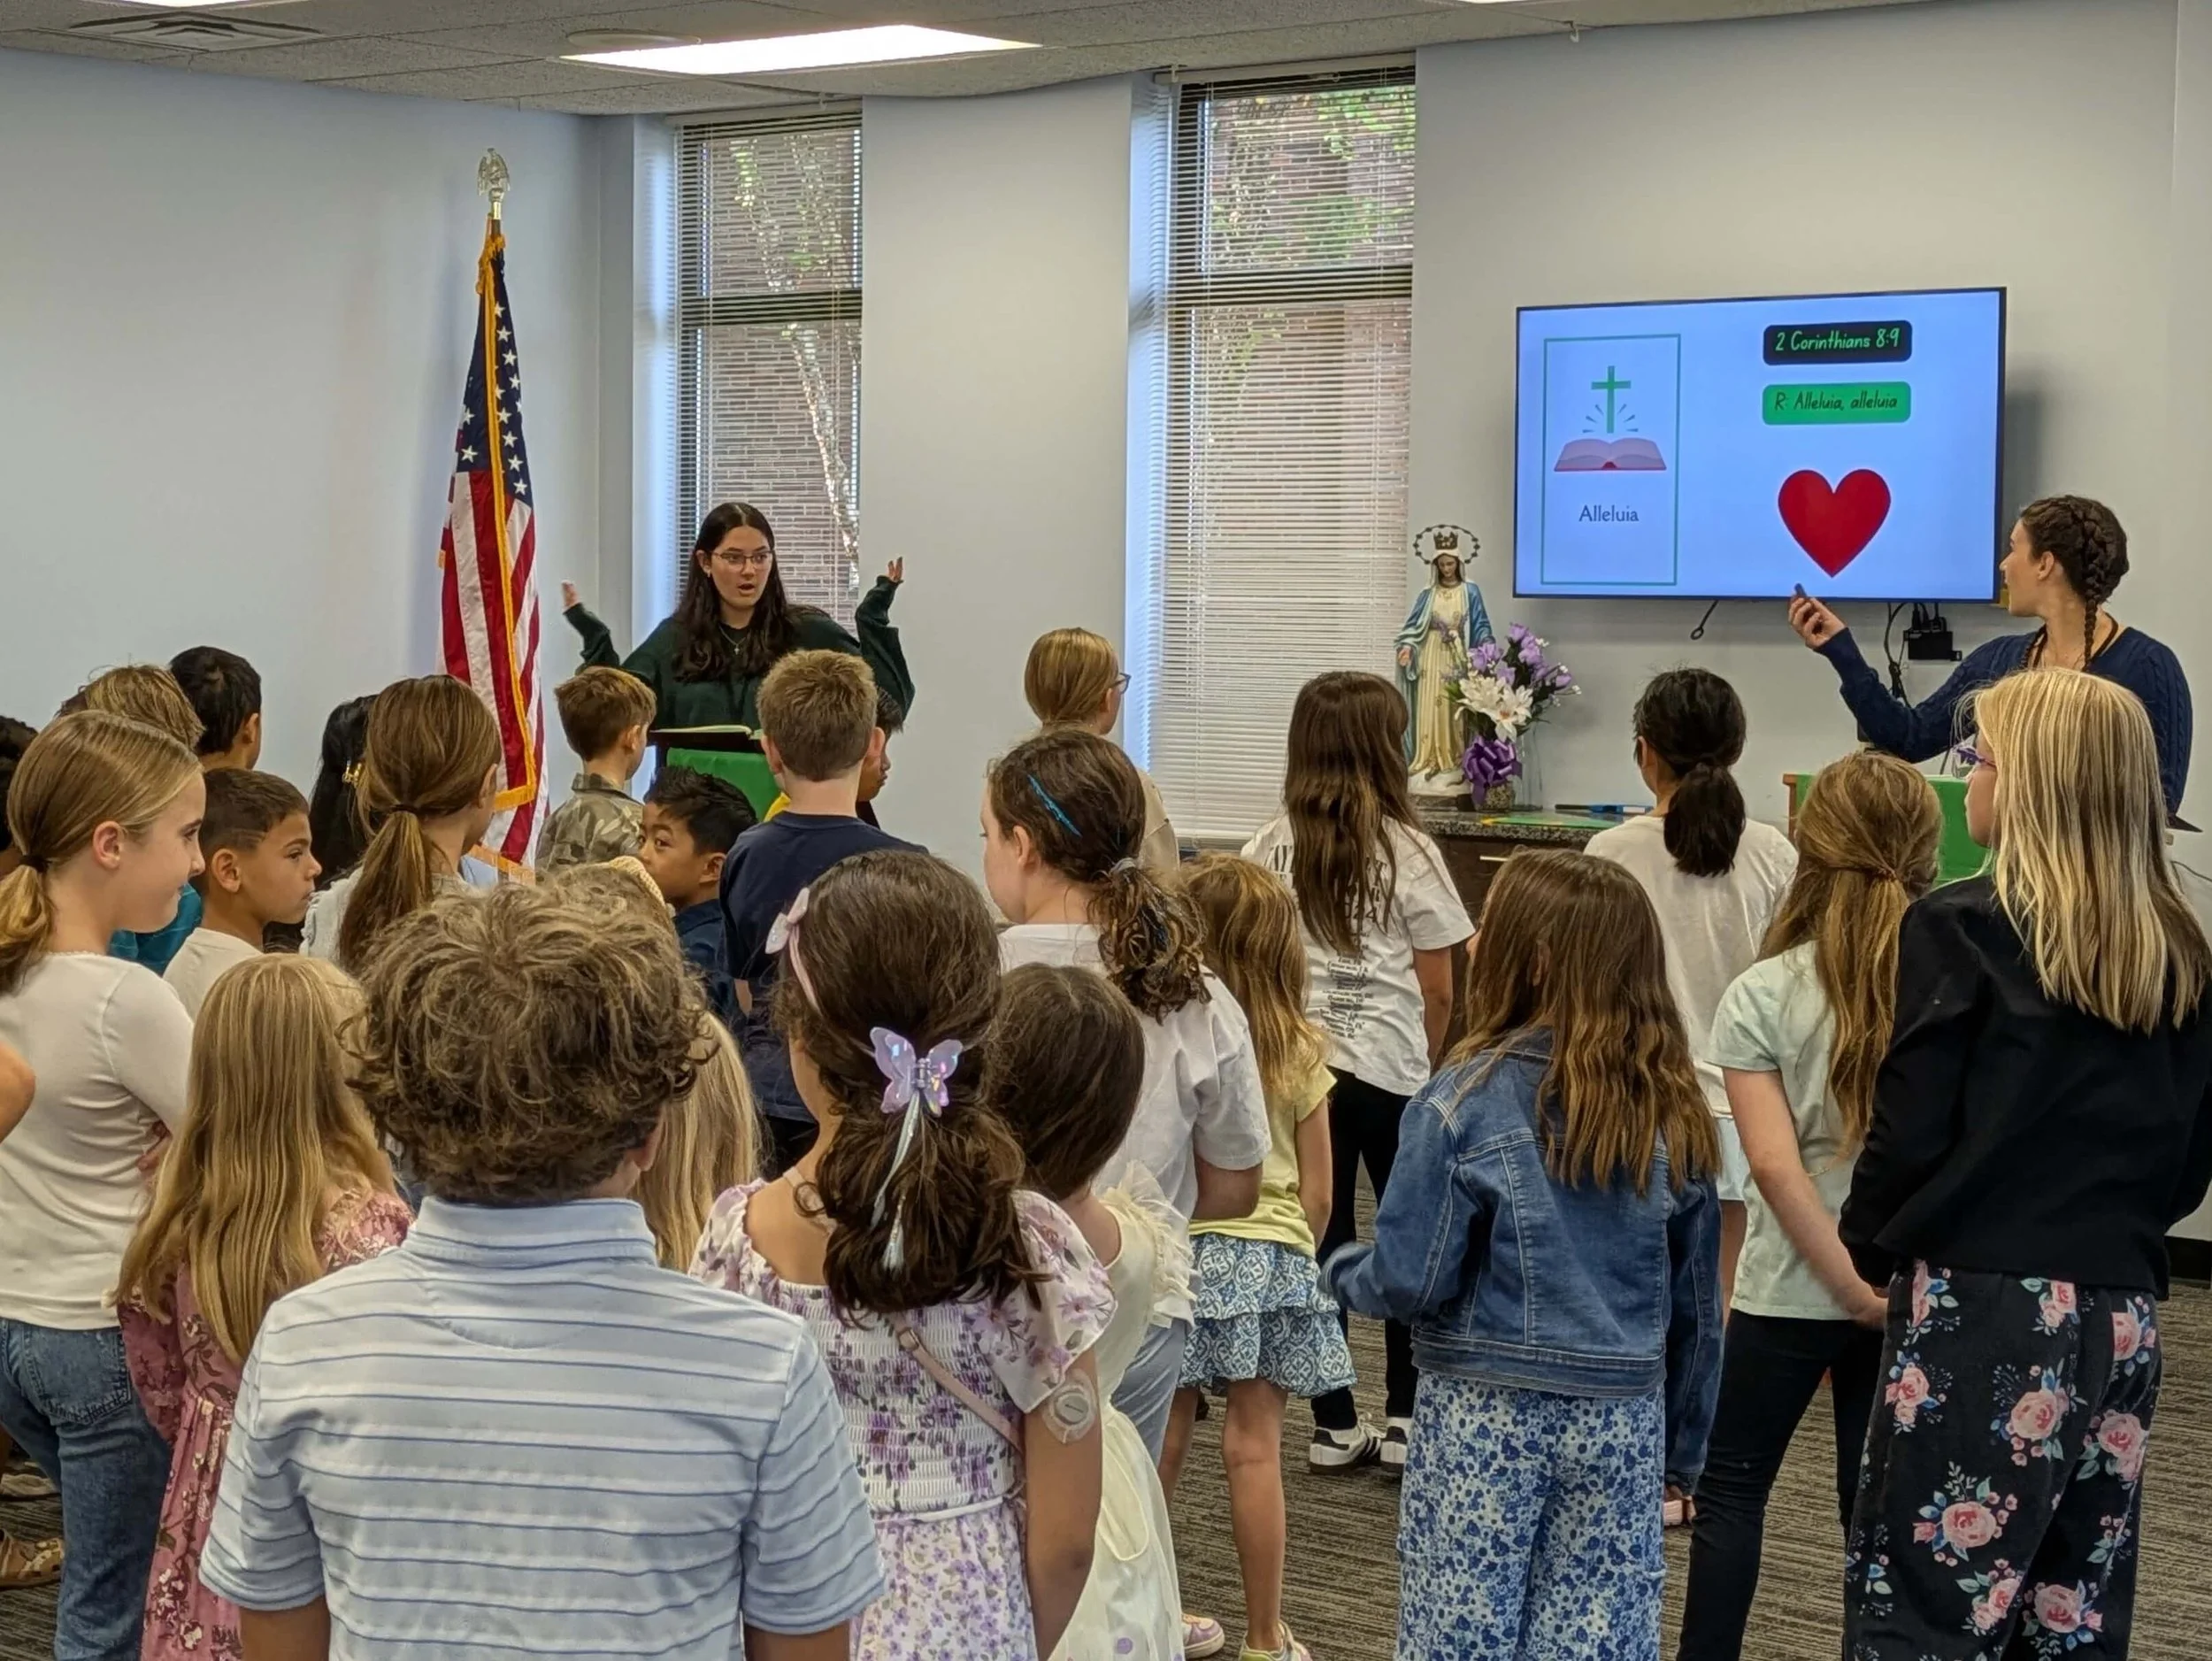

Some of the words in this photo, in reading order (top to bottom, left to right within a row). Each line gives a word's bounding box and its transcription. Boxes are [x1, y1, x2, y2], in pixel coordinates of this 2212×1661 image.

[1775, 331, 1786, 351] 2
[1790, 330, 1870, 351] Corinthians
[1876, 327, 1901, 348] 8:9
[1793, 391, 1845, 411] Alleluia,
[1850, 389, 1898, 410] alleluia
[1578, 504, 1640, 522] Alleluia
